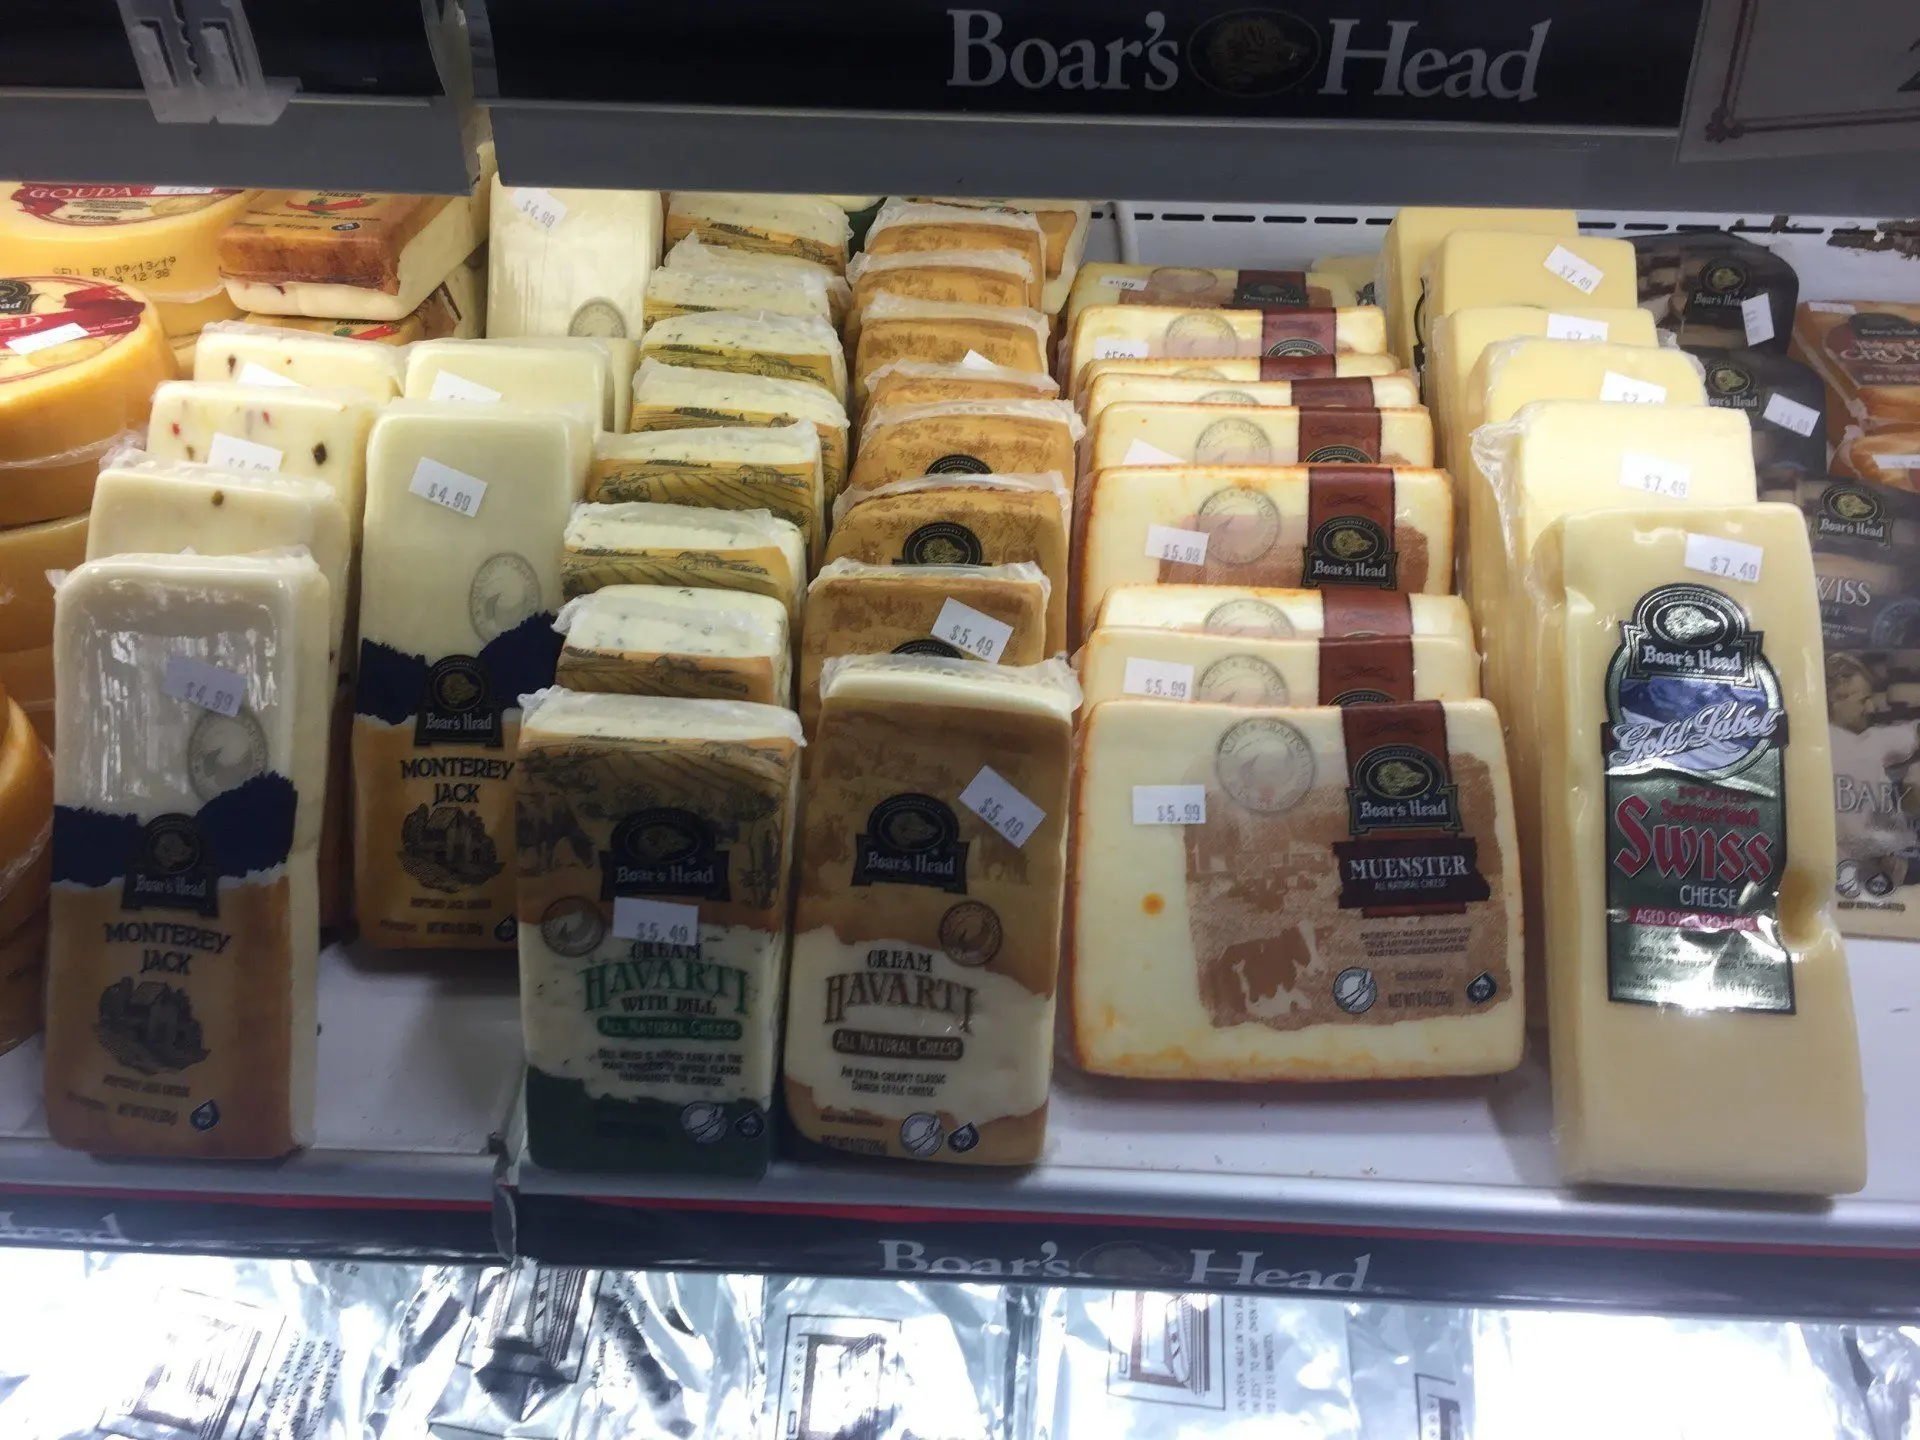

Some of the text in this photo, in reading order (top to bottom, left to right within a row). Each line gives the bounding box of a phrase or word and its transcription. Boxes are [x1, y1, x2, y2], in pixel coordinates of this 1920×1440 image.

[946, 8, 1552, 102] Boar's Head
[29, 186, 133, 199] GOUDA
[92, 267, 107, 277] BY
[114, 256, 176, 276] 09/13/19
[1558, 264, 1593, 290] $7.49
[1694, 292, 1721, 305] Boar's
[1732, 393, 1758, 408] Head
[1643, 474, 1686, 495] $7.49
[427, 482, 472, 512] $4.99
[1819, 517, 1884, 538] Boar's Head
[1163, 543, 1201, 564] $5.99
[1314, 559, 1387, 578] Boar's Head
[1709, 556, 1758, 580] $7.49
[949, 624, 994, 657] $5.49
[1641, 644, 1743, 672] Boar's Head
[1144, 678, 1187, 699] $5.99
[425, 712, 493, 731] Boar's Head
[1608, 700, 1784, 767] Gold Label
[400, 756, 515, 780] MONTEREY
[432, 783, 480, 806] JACK
[1835, 774, 1913, 815] BABY
[979, 797, 1025, 839] $5.49
[1156, 803, 1201, 823] $5.99
[1360, 799, 1448, 819] Boar's Head
[614, 864, 715, 884] Boar's Head
[866, 850, 955, 875] Boar's Head
[1348, 853, 1469, 881] MUENSTER
[134, 872, 207, 897] Boar's Head
[1678, 884, 1738, 909] CHEESE
[1634, 908, 1666, 925] AGED
[103, 922, 232, 954] MONTEREY
[635, 921, 690, 944] $5.49
[139, 949, 193, 975] JACK
[866, 950, 933, 973] CREAM
[576, 959, 750, 1016] HAVARTI
[620, 994, 718, 1017] WITH DILL
[823, 971, 979, 1037] HAVARTI
[836, 1031, 960, 1057] ALL NATURAL CHEESE
[854, 1067, 878, 1080] EXTRA
[880, 1070, 914, 1083] CREAMY
[915, 1073, 946, 1085] CLASSIC
[878, 1239, 1373, 1294] Boar's Head
